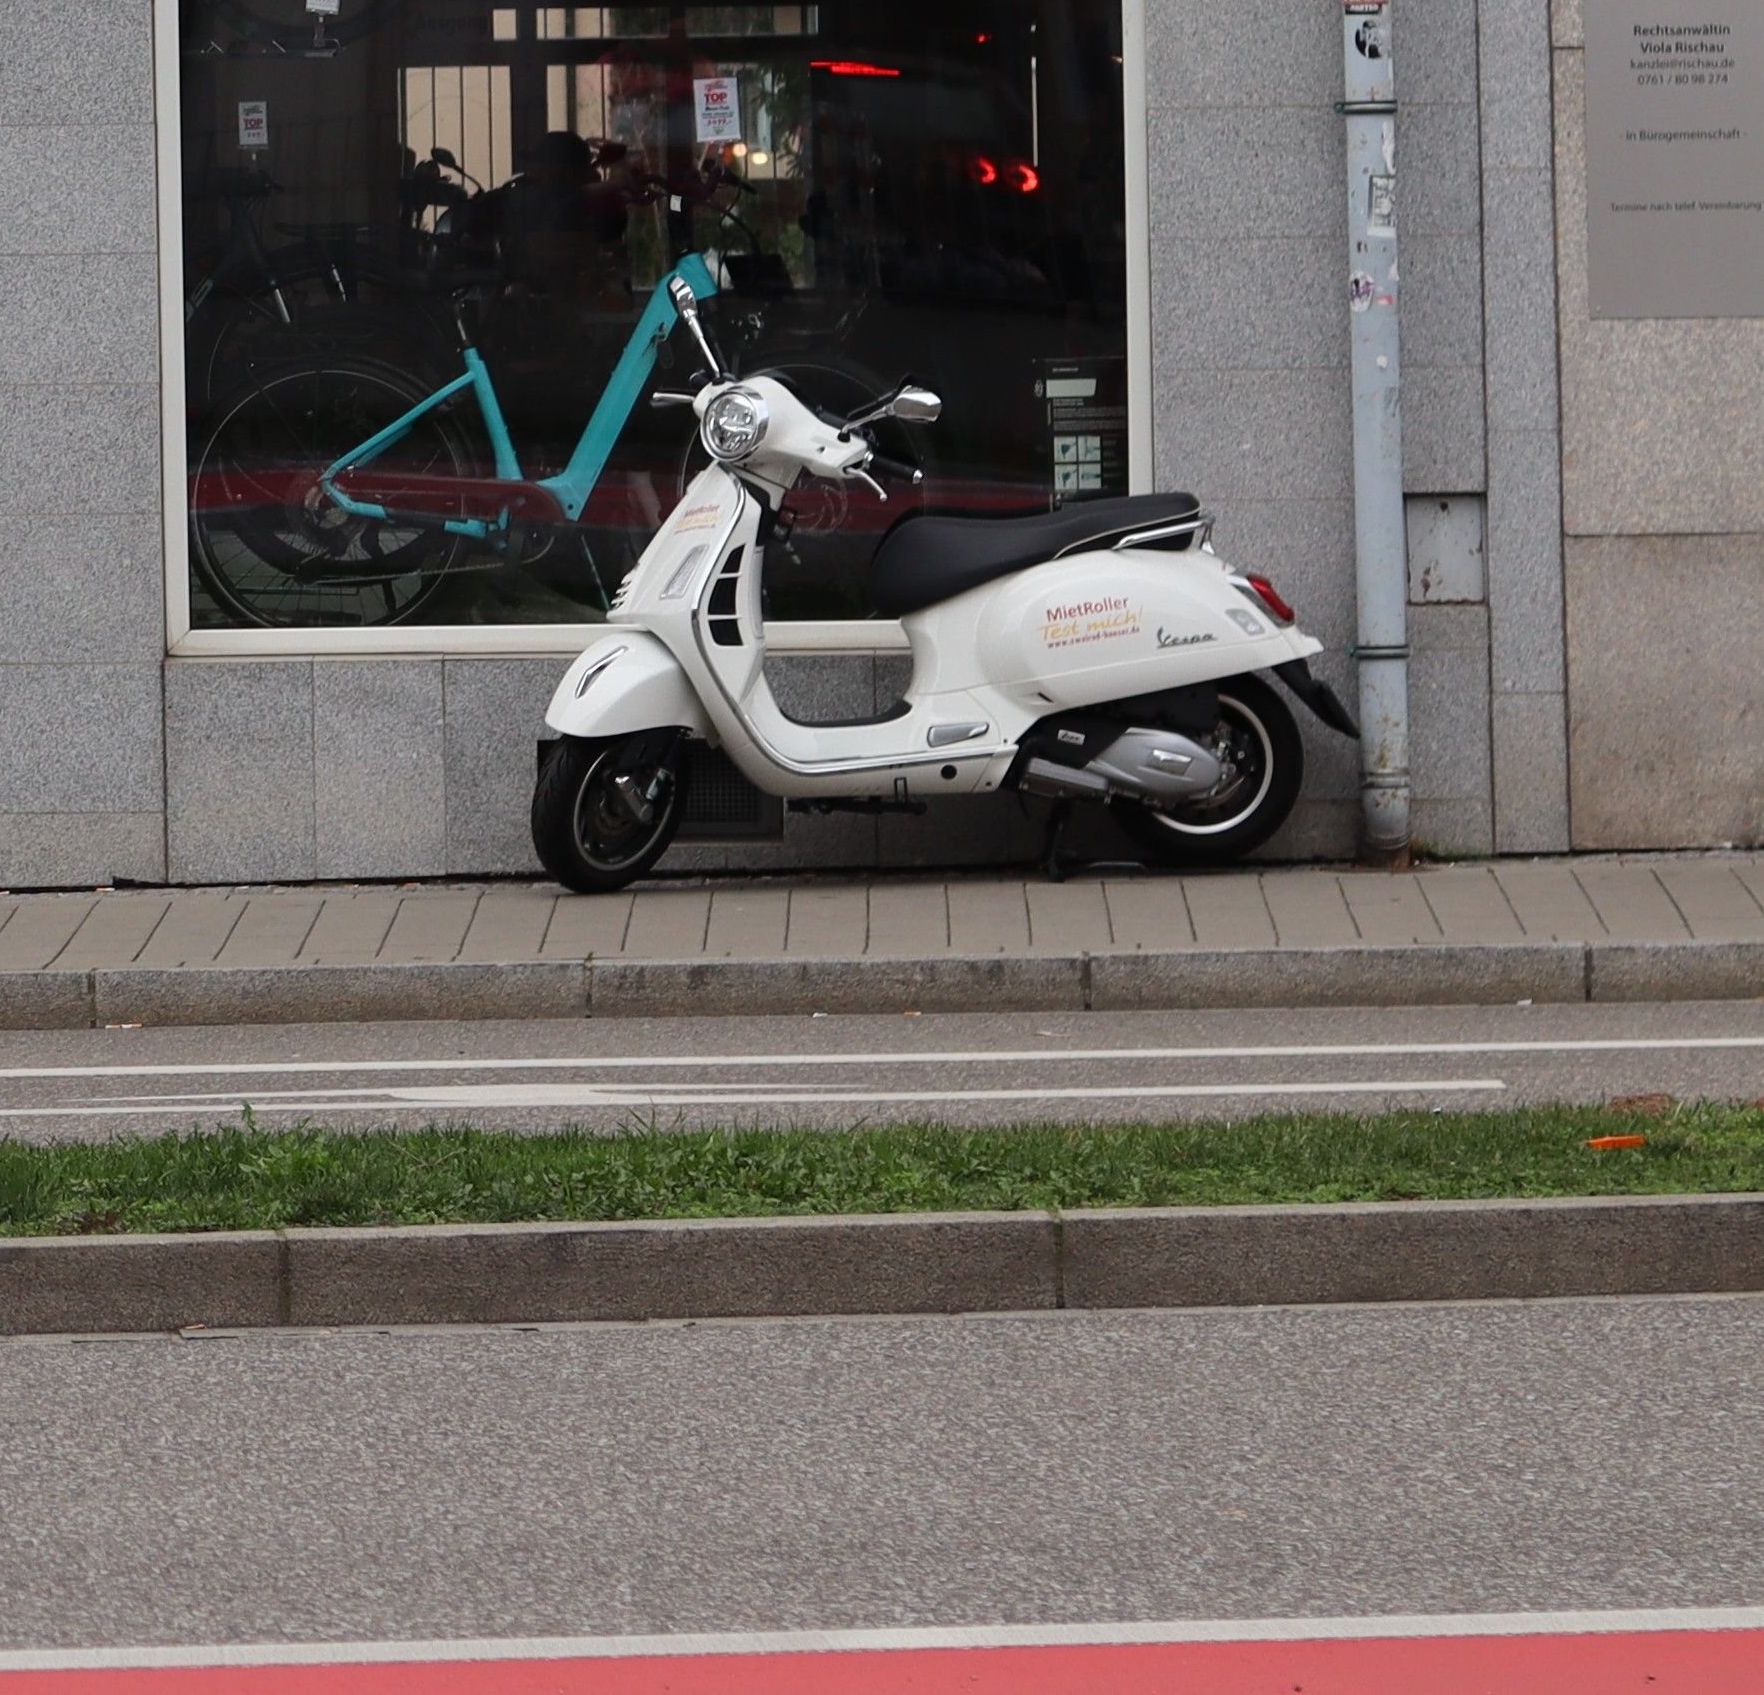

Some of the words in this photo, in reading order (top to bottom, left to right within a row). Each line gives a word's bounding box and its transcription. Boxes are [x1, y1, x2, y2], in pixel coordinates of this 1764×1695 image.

[1633, 24, 1731, 37] Rechtsanwältin
[1640, 42, 1672, 54] Viola
[1675, 42, 1725, 54] Rischau
[704, 92, 728, 102] TOP
[1639, 129, 1740, 143] Bürogemeinschaft
[1046, 597, 1129, 622] MietRoller
[1038, 620, 1080, 642] Test
[1157, 626, 1218, 649] Vespa
